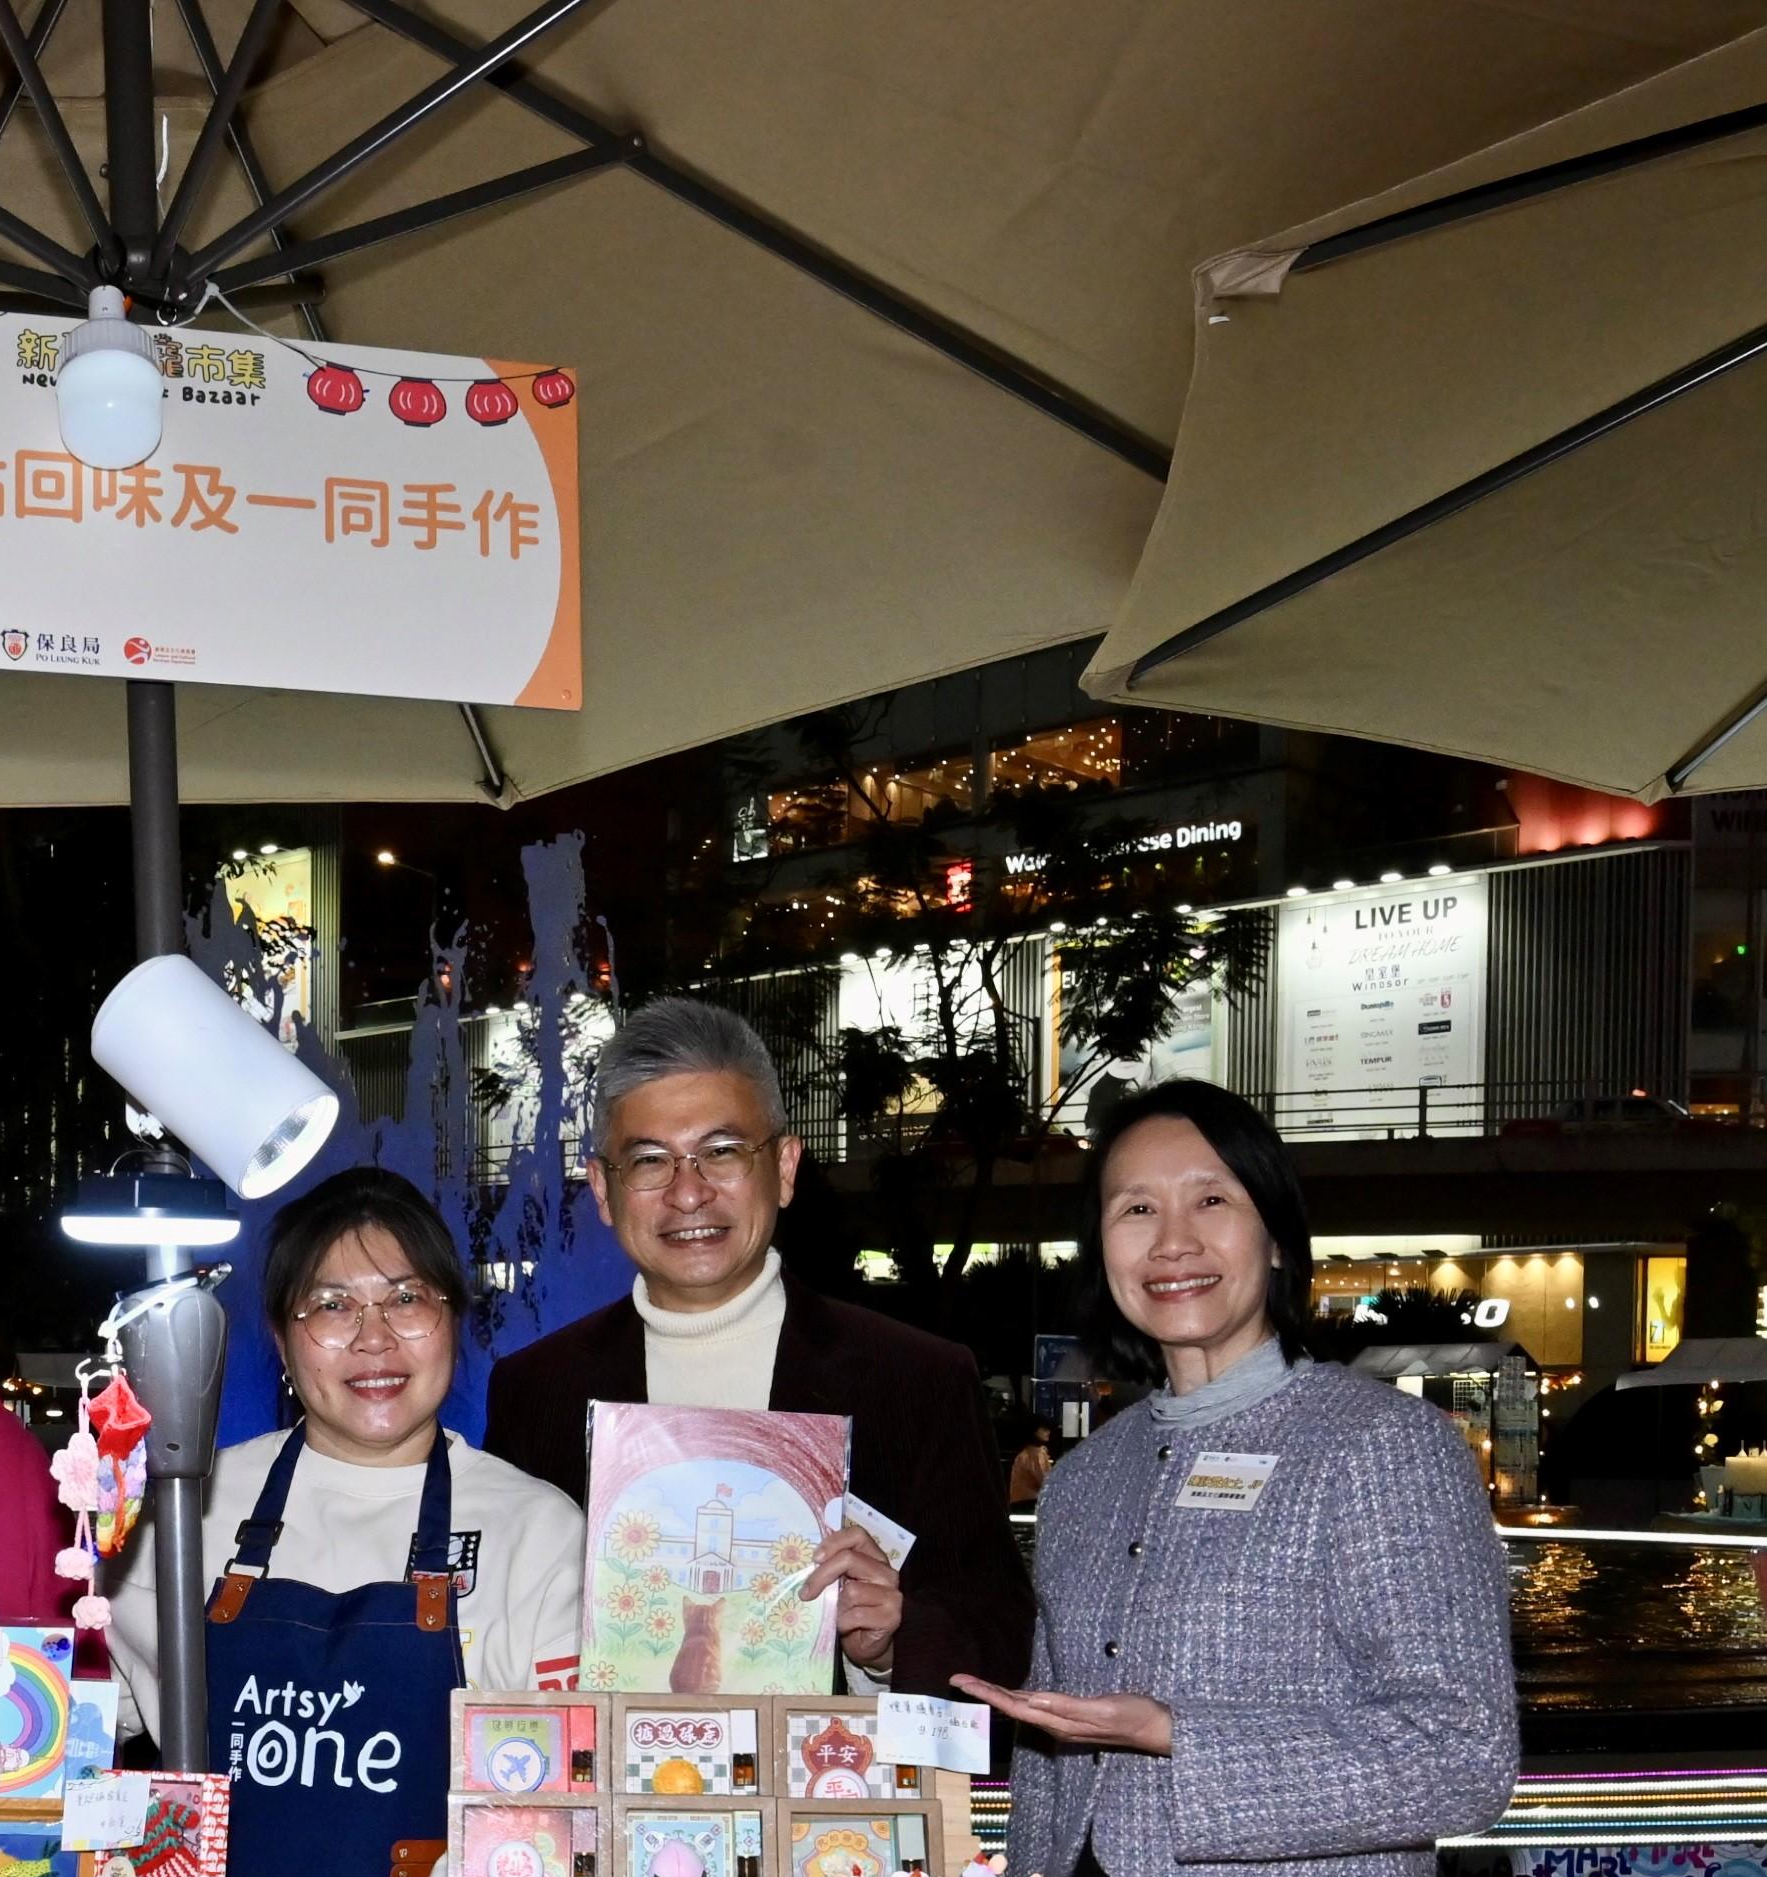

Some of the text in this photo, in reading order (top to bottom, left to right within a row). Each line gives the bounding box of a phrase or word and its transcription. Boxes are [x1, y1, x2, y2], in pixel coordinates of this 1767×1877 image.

[182, 386, 261, 407] Bazaar
[35, 632, 101, 655] 保良局
[1177, 820, 1242, 850] Dining
[1354, 896, 1458, 930] LIVE UP
[234, 1674, 342, 1726] Artsy
[227, 1721, 245, 1782] 一同手作
[815, 1744, 859, 1765] 平安
